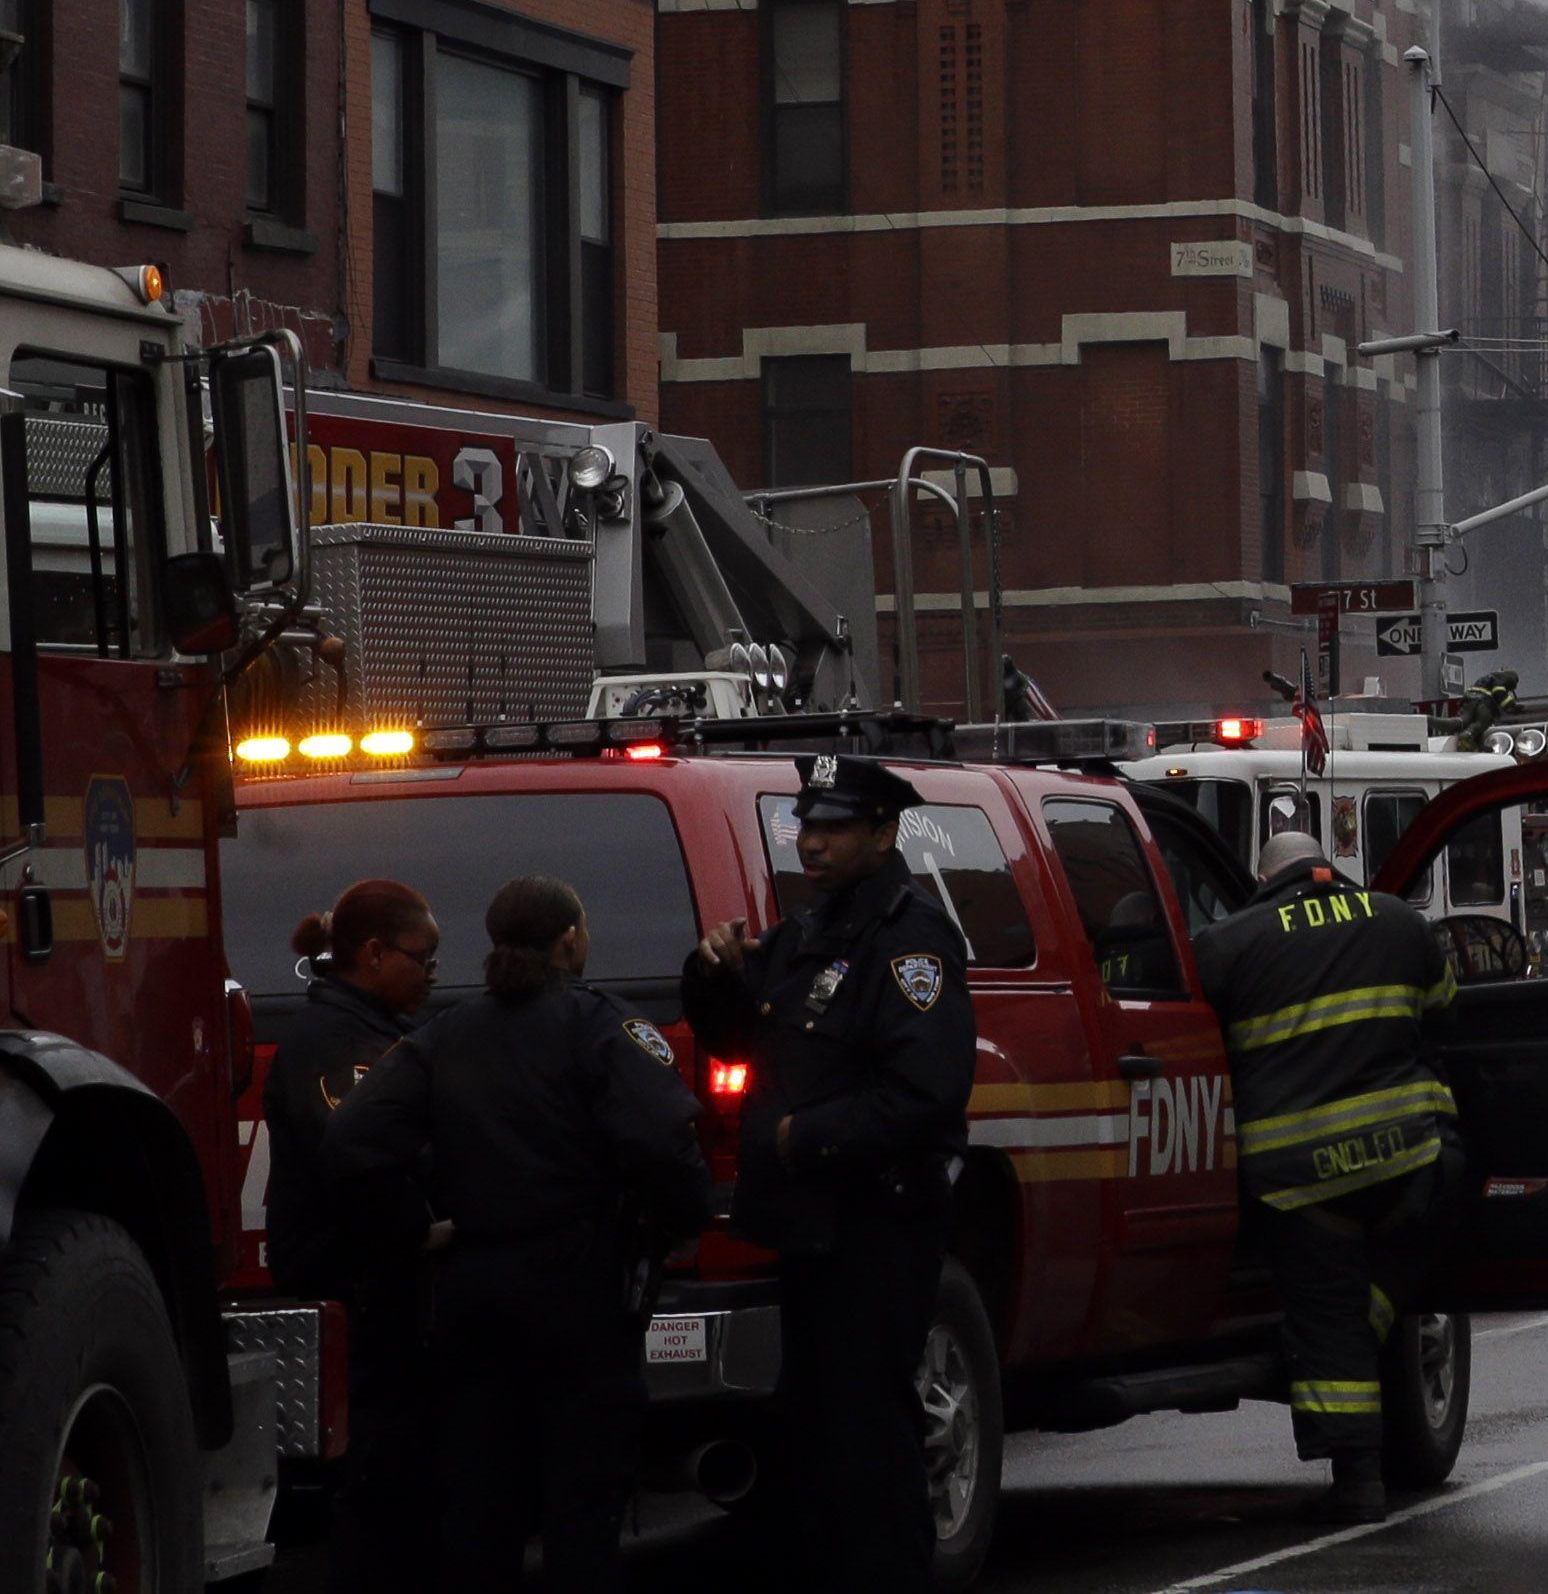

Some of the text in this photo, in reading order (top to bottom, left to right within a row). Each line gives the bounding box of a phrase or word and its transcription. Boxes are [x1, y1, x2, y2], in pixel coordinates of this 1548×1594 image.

[306, 443, 503, 534] DDER 3
[1360, 590, 1377, 608] St
[1450, 623, 1487, 640] WAY
[1128, 1074, 1222, 1178] FDNY
[651, 1321, 700, 1333] DANGER
[664, 1335, 688, 1346] HOT
[650, 1349, 703, 1361] EXHAUST
